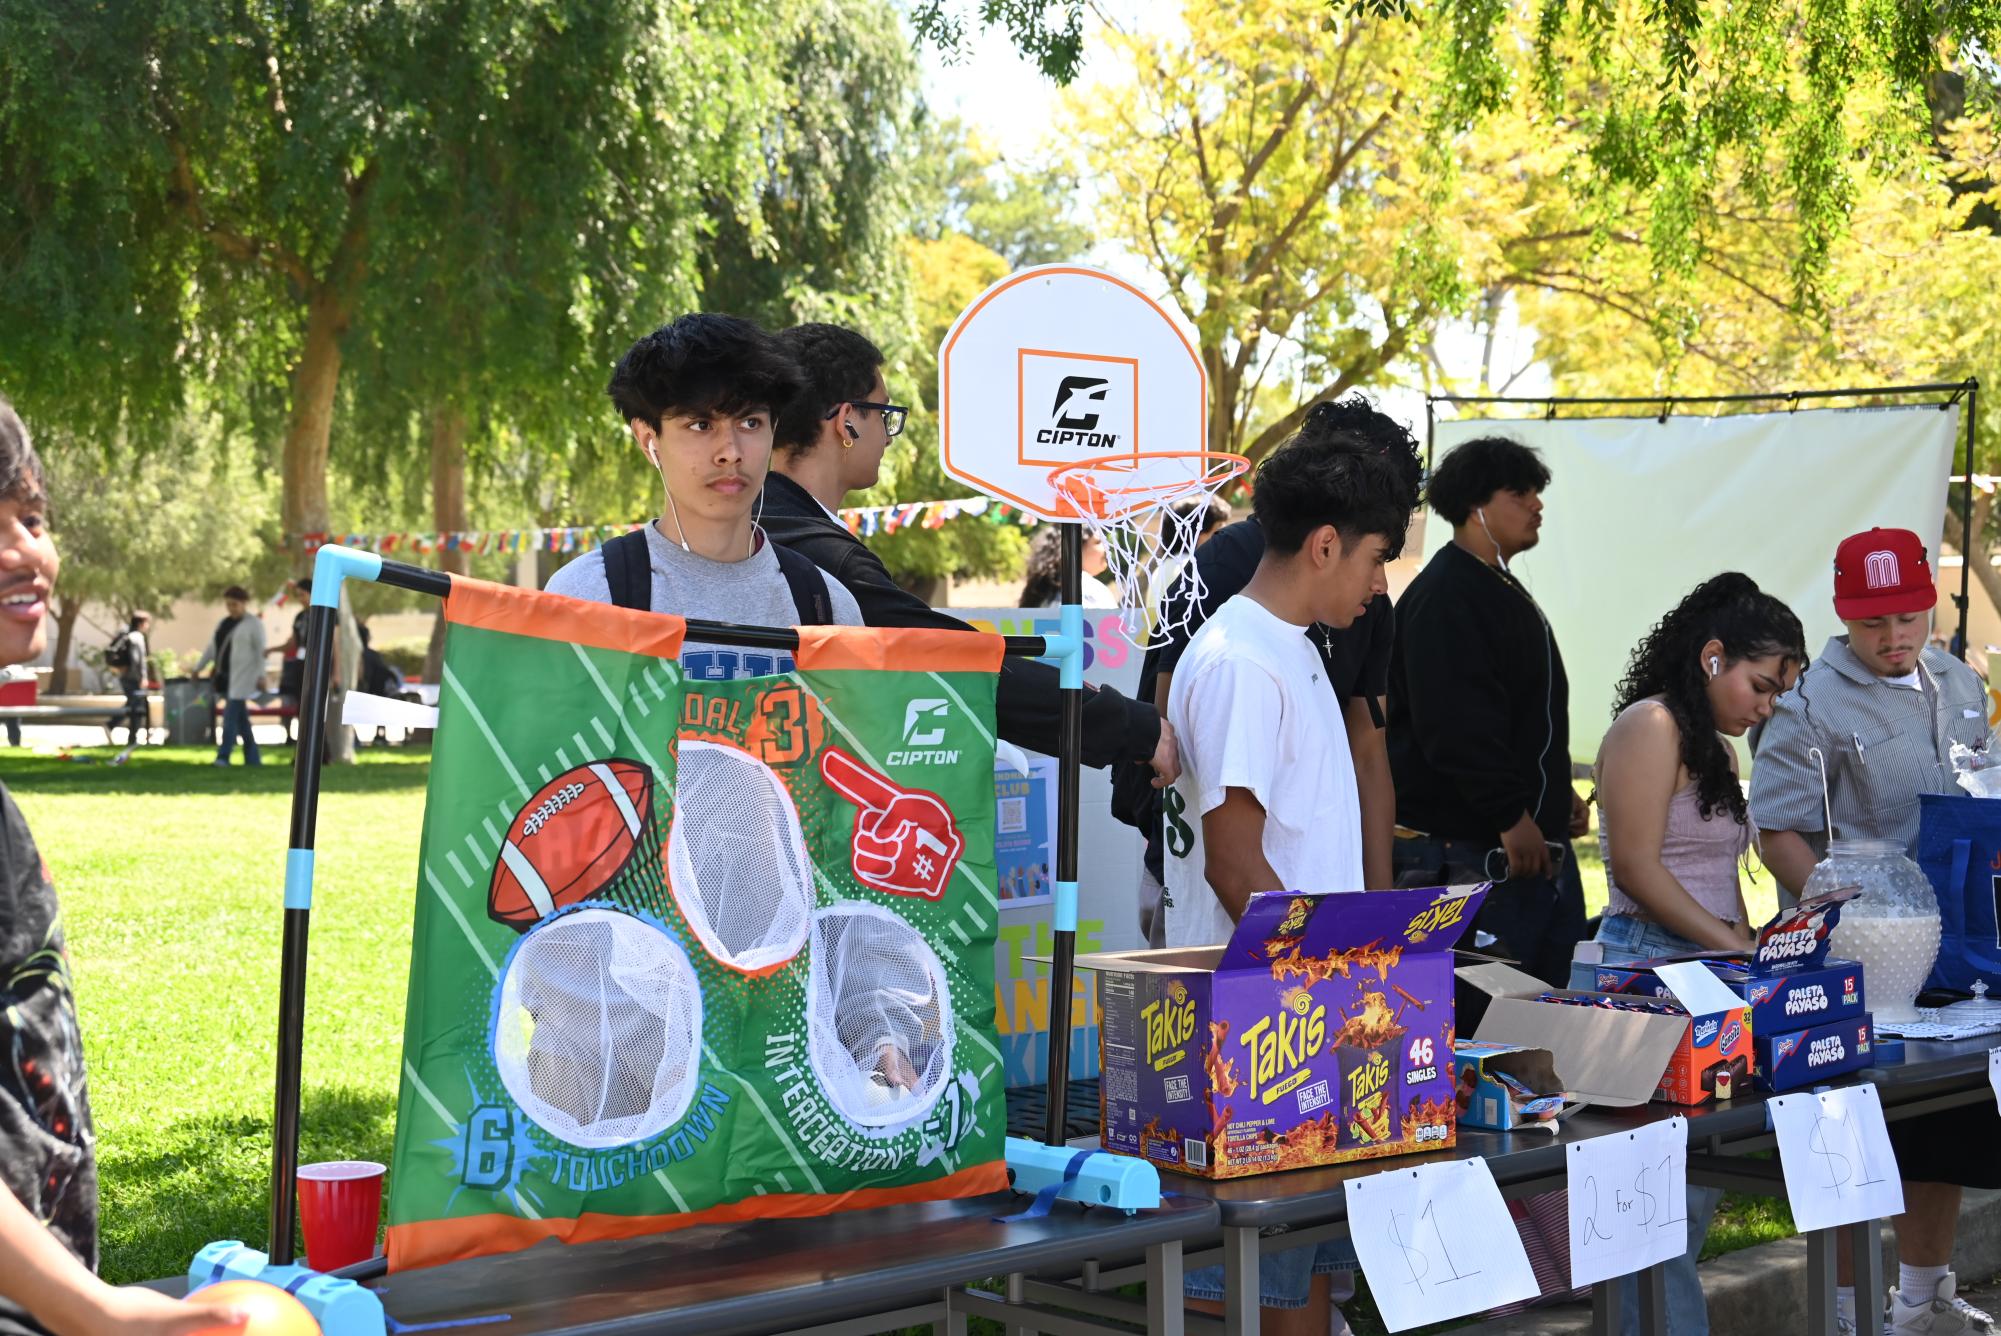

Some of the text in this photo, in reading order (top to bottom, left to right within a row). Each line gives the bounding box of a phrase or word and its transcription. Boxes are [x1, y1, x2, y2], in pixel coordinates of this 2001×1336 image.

[1036, 428, 1117, 448] CIPTON
[679, 692, 741, 735] OAL
[761, 686, 810, 769] 3
[886, 750, 960, 766] CIPTON
[912, 827, 948, 881] #1
[1768, 928, 1816, 947] PALETA
[1759, 940, 1818, 963] PAYASO
[1788, 984, 1825, 1002] PALETA
[1844, 978, 1853, 991] 15
[1785, 996, 1829, 1015] PAYASO
[1140, 987, 1196, 1065] Takis
[1743, 1012, 1751, 1022] 32
[1810, 1035, 1842, 1053] PALETA
[1857, 1027, 1866, 1041] 15
[1240, 993, 1326, 1100] Takis
[1409, 1037, 1434, 1067] 46
[1807, 1046, 1845, 1067] PAYASO
[1347, 1053, 1389, 1108] Takis
[1406, 1066, 1437, 1085] SINGLES
[1299, 1083, 1327, 1101] FACE THE
[1300, 1092, 1328, 1111] INTENSITY
[461, 1103, 514, 1191] 6
[551, 1082, 732, 1192] TOUCHDOWN
[1808, 1107, 1888, 1200] $1
[1583, 1175, 1613, 1246] 2
[1634, 1154, 1688, 1233] $1
[1387, 1199, 1482, 1296] $1
